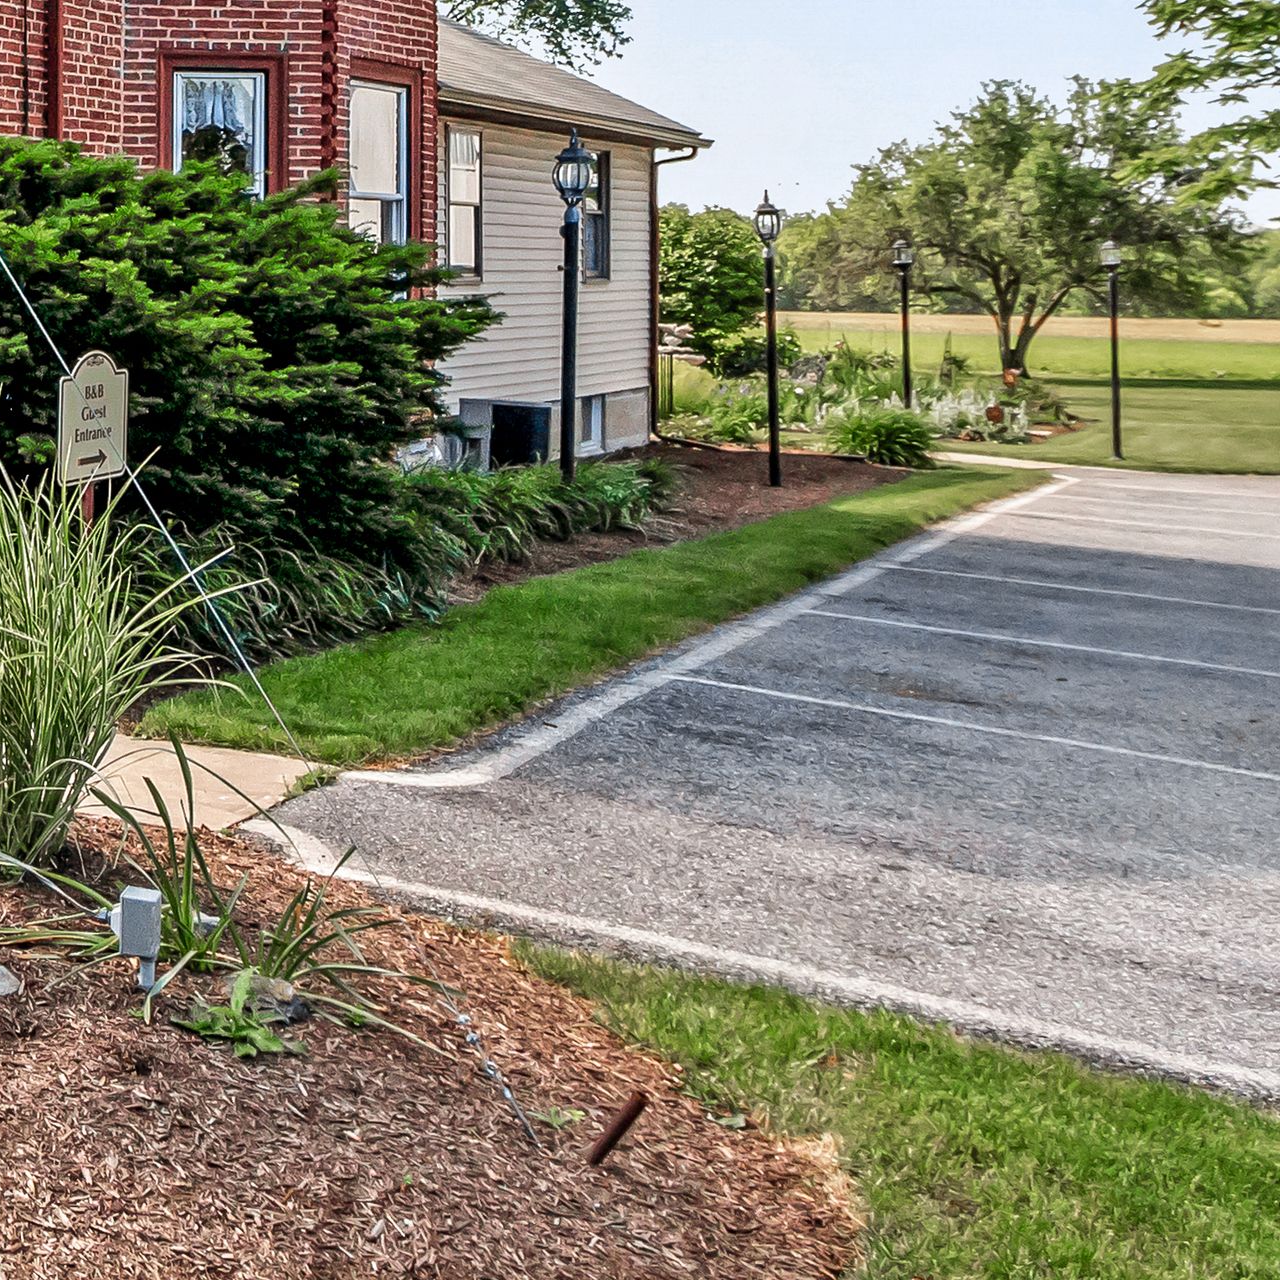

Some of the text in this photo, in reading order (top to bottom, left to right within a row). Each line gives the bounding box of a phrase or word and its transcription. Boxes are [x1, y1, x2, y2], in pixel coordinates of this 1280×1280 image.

[85, 384, 104, 400] B&B
[81, 405, 107, 421] Guest
[75, 426, 112, 443] Entrance
